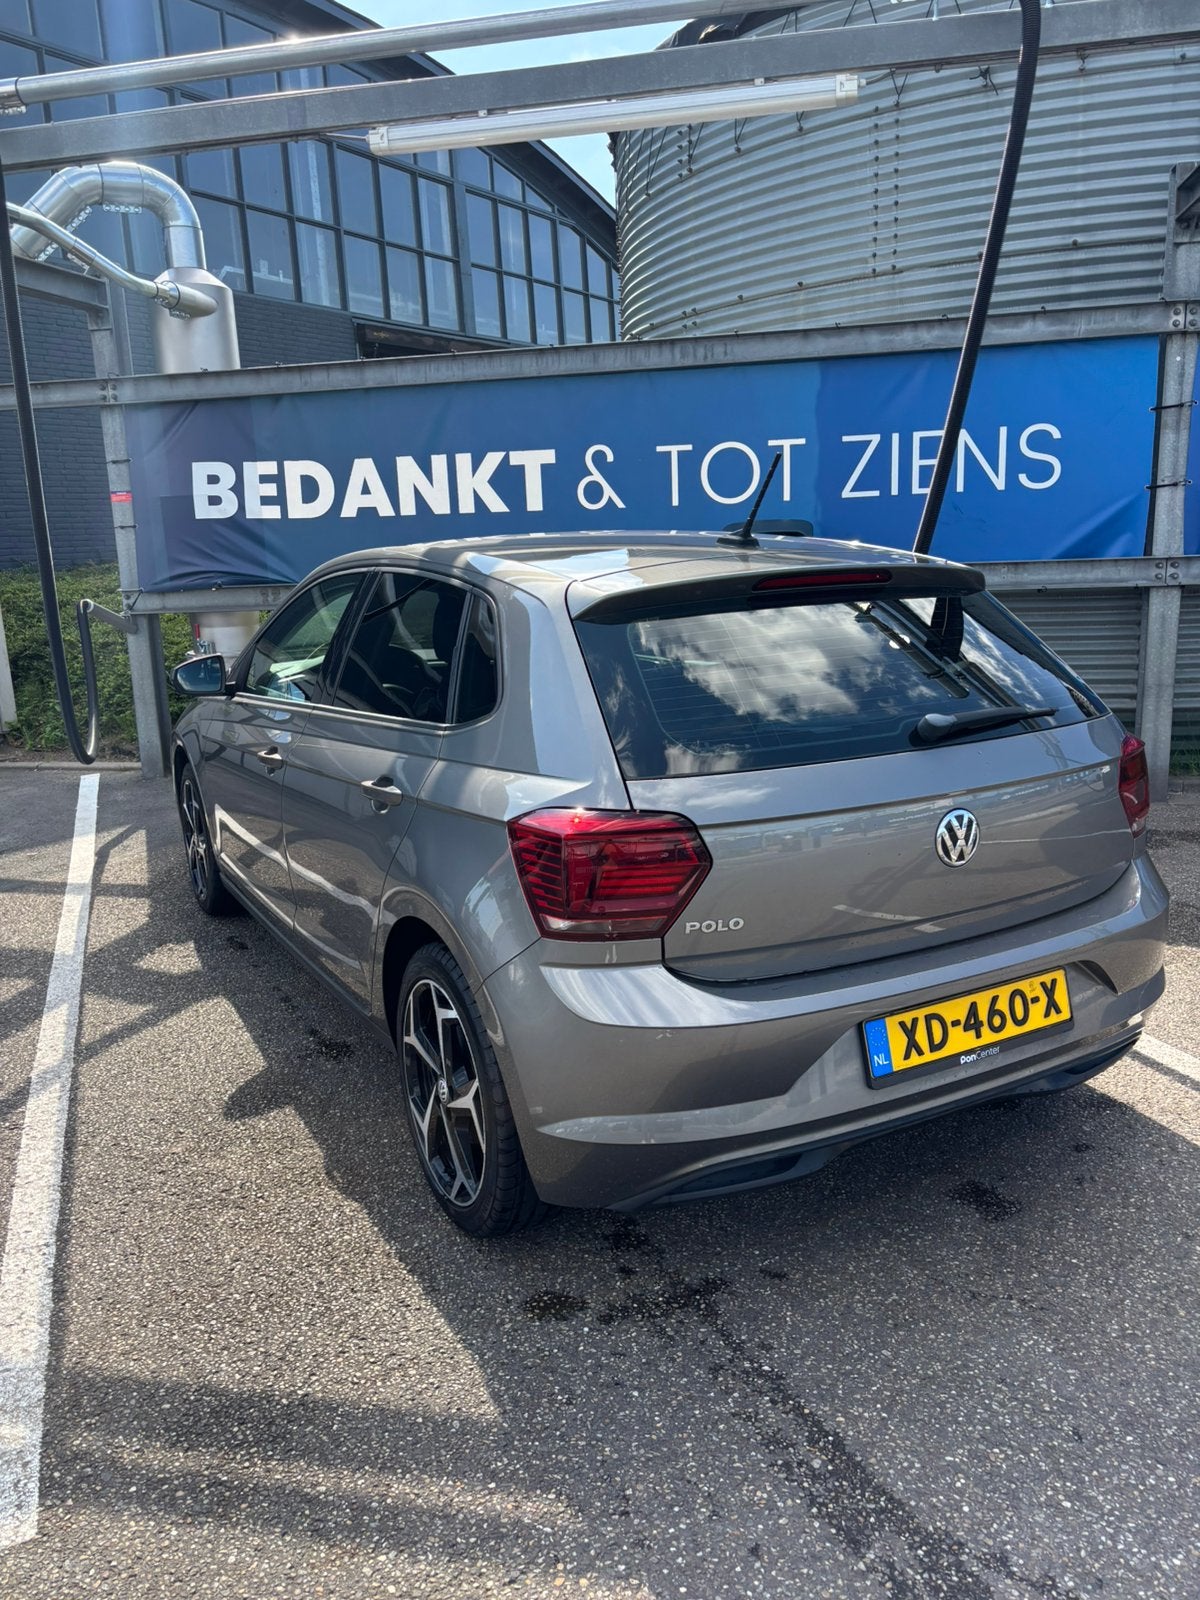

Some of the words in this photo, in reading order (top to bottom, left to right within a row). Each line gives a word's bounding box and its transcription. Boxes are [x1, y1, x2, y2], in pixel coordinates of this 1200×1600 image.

[191, 448, 556, 520] BEDANKT
[576, 444, 626, 510] &
[656, 438, 806, 506] TOT
[841, 422, 1063, 499] ZIENS
[685, 917, 745, 935] POLO
[898, 977, 1063, 1061] XD-460-X
[873, 1053, 890, 1067] NL
